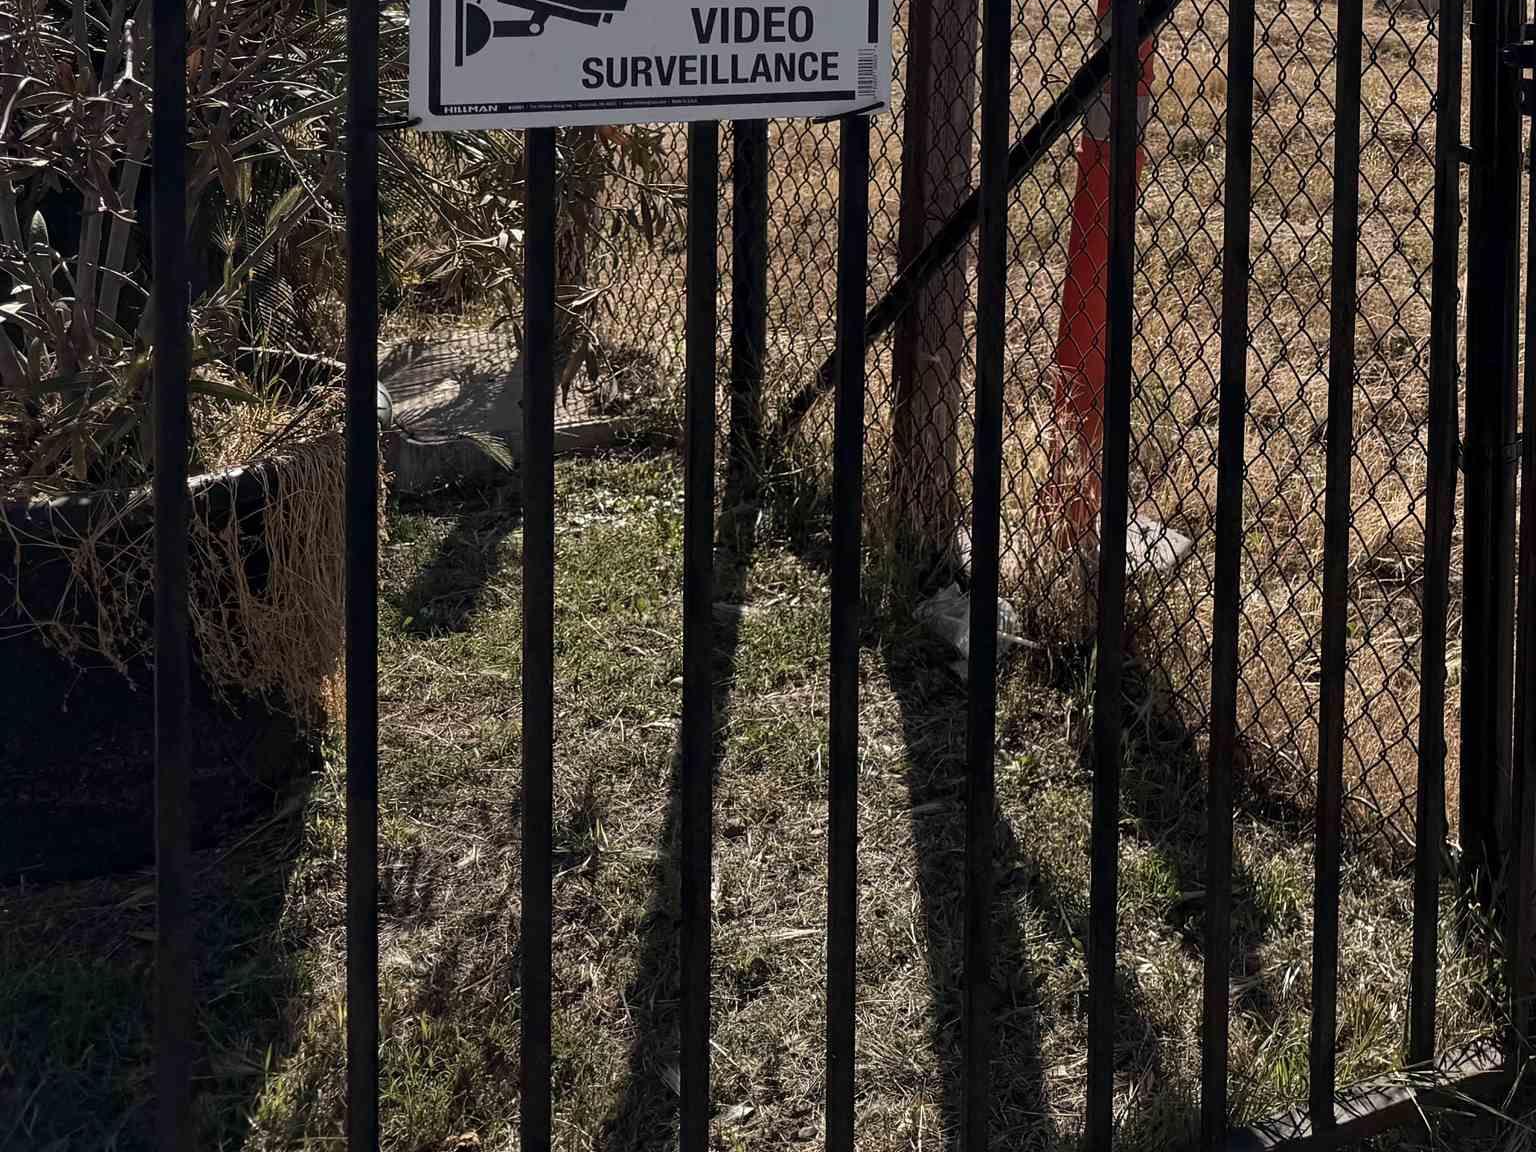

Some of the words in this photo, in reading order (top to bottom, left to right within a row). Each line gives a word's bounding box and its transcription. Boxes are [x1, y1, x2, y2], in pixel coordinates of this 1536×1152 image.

[691, 5, 814, 44] VIDEO
[581, 51, 840, 89] SURVEILLANCE
[444, 104, 498, 114] HILLMAN
